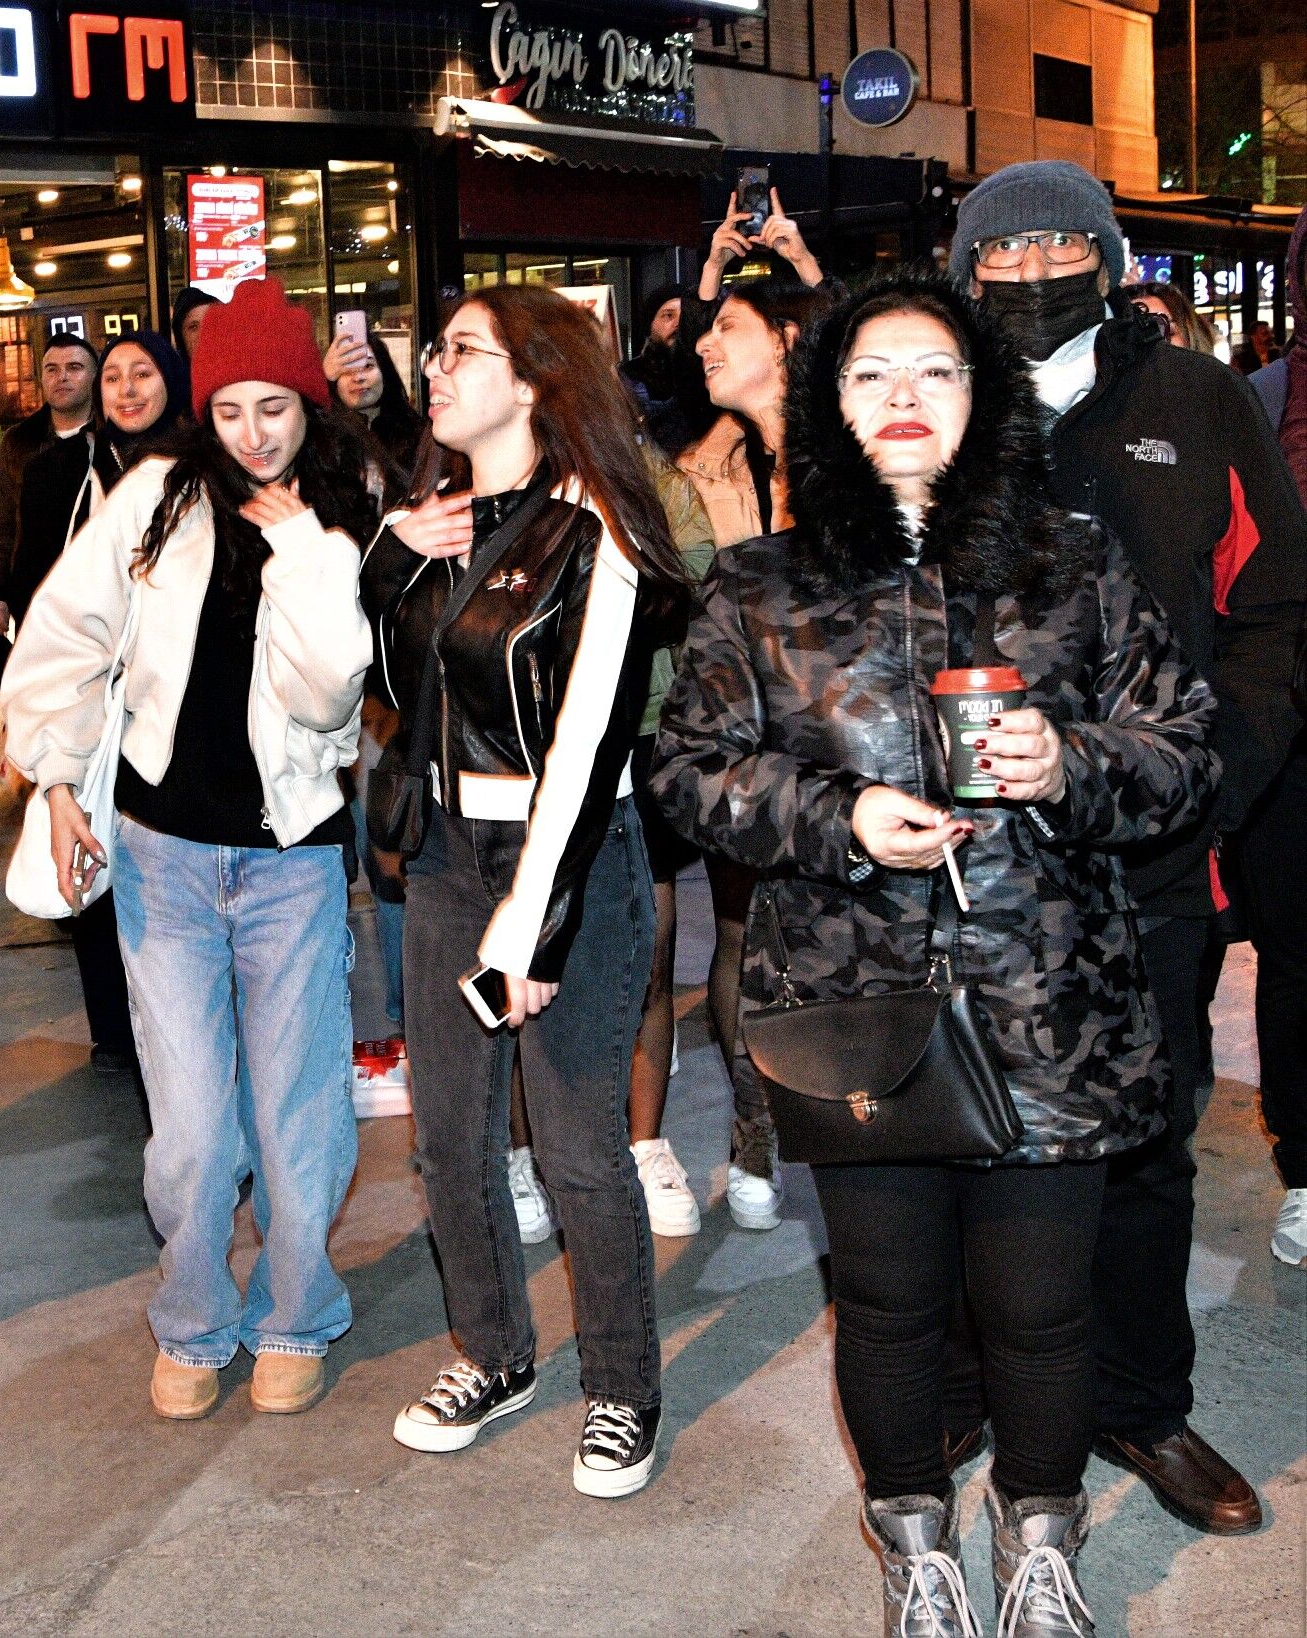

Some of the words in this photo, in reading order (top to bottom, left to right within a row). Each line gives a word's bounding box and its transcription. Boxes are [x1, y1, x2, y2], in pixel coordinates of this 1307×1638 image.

[69, 13, 187, 102] rm
[1139, 438, 1157, 447] THE
[1125, 444, 1158, 454] NORTH
[1134, 452, 1158, 462] FACE
